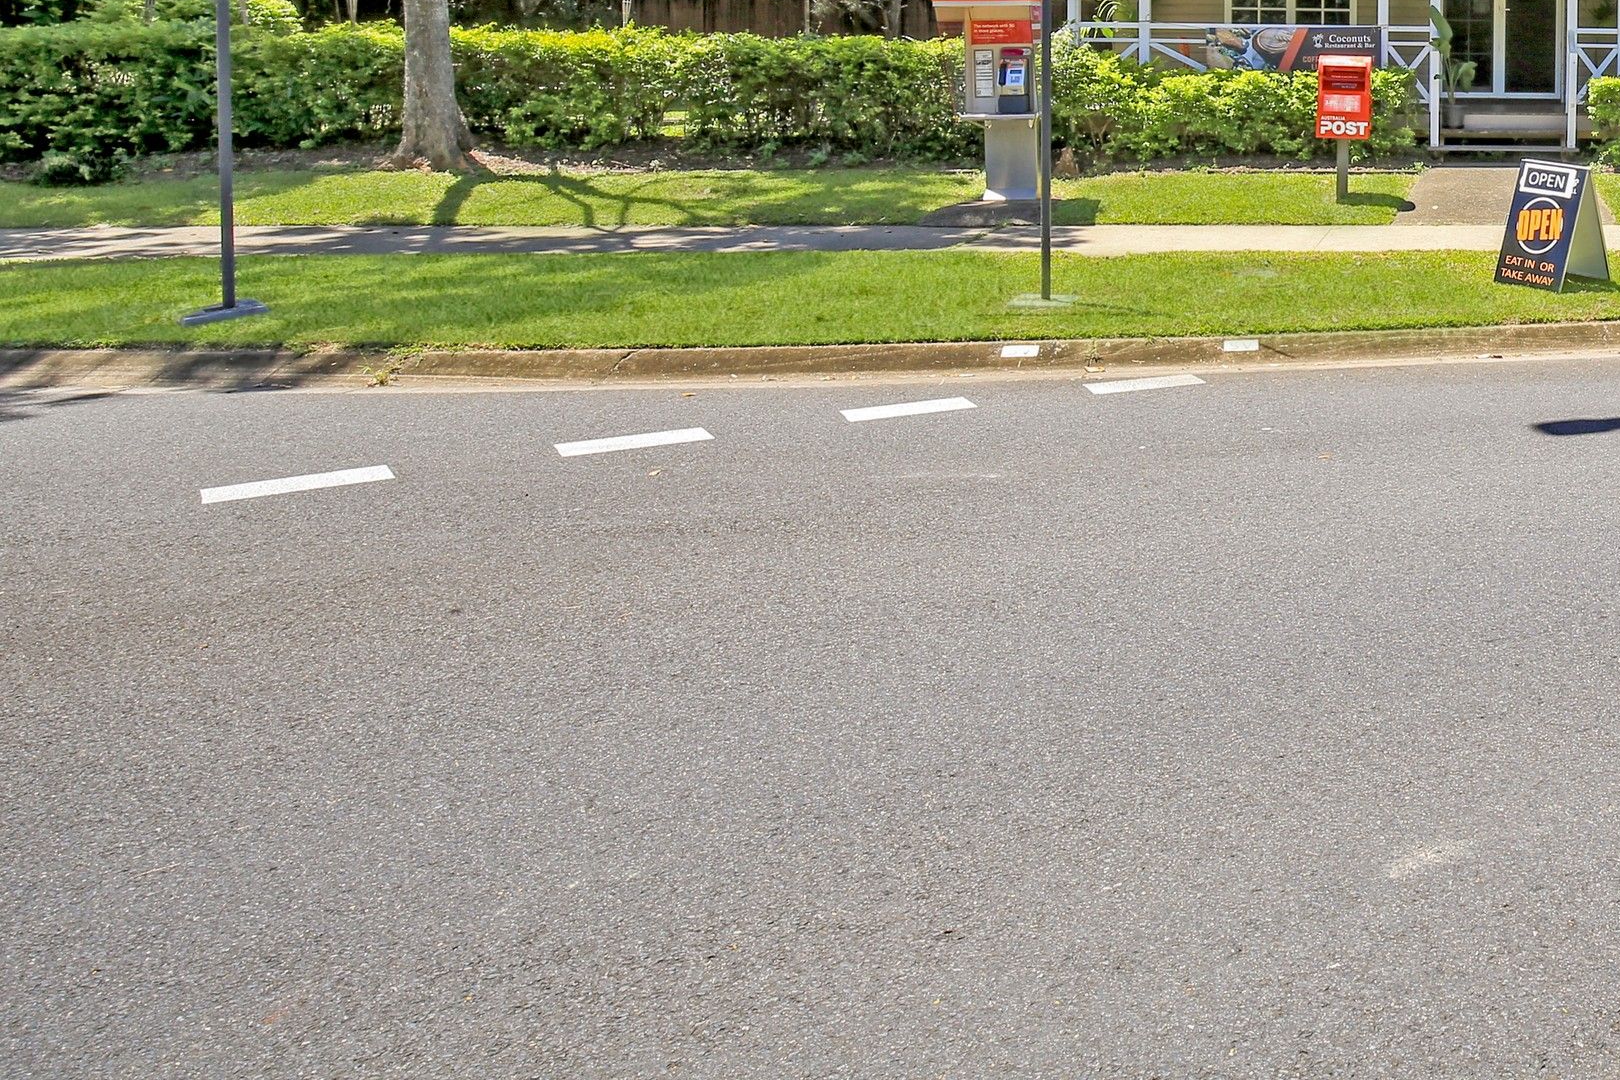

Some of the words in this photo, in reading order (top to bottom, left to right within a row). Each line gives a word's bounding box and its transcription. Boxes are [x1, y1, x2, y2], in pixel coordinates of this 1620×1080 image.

[1329, 34, 1371, 43] Coconuts
[1320, 120, 1369, 136] POST
[1528, 171, 1566, 189] OPEN
[1516, 208, 1563, 241] OPEN
[1505, 255, 1524, 266] EAT
[1524, 259, 1536, 269] IN
[1539, 262, 1555, 273] OR
[1501, 267, 1524, 281] TAKE
[1524, 273, 1554, 286] AWAY
